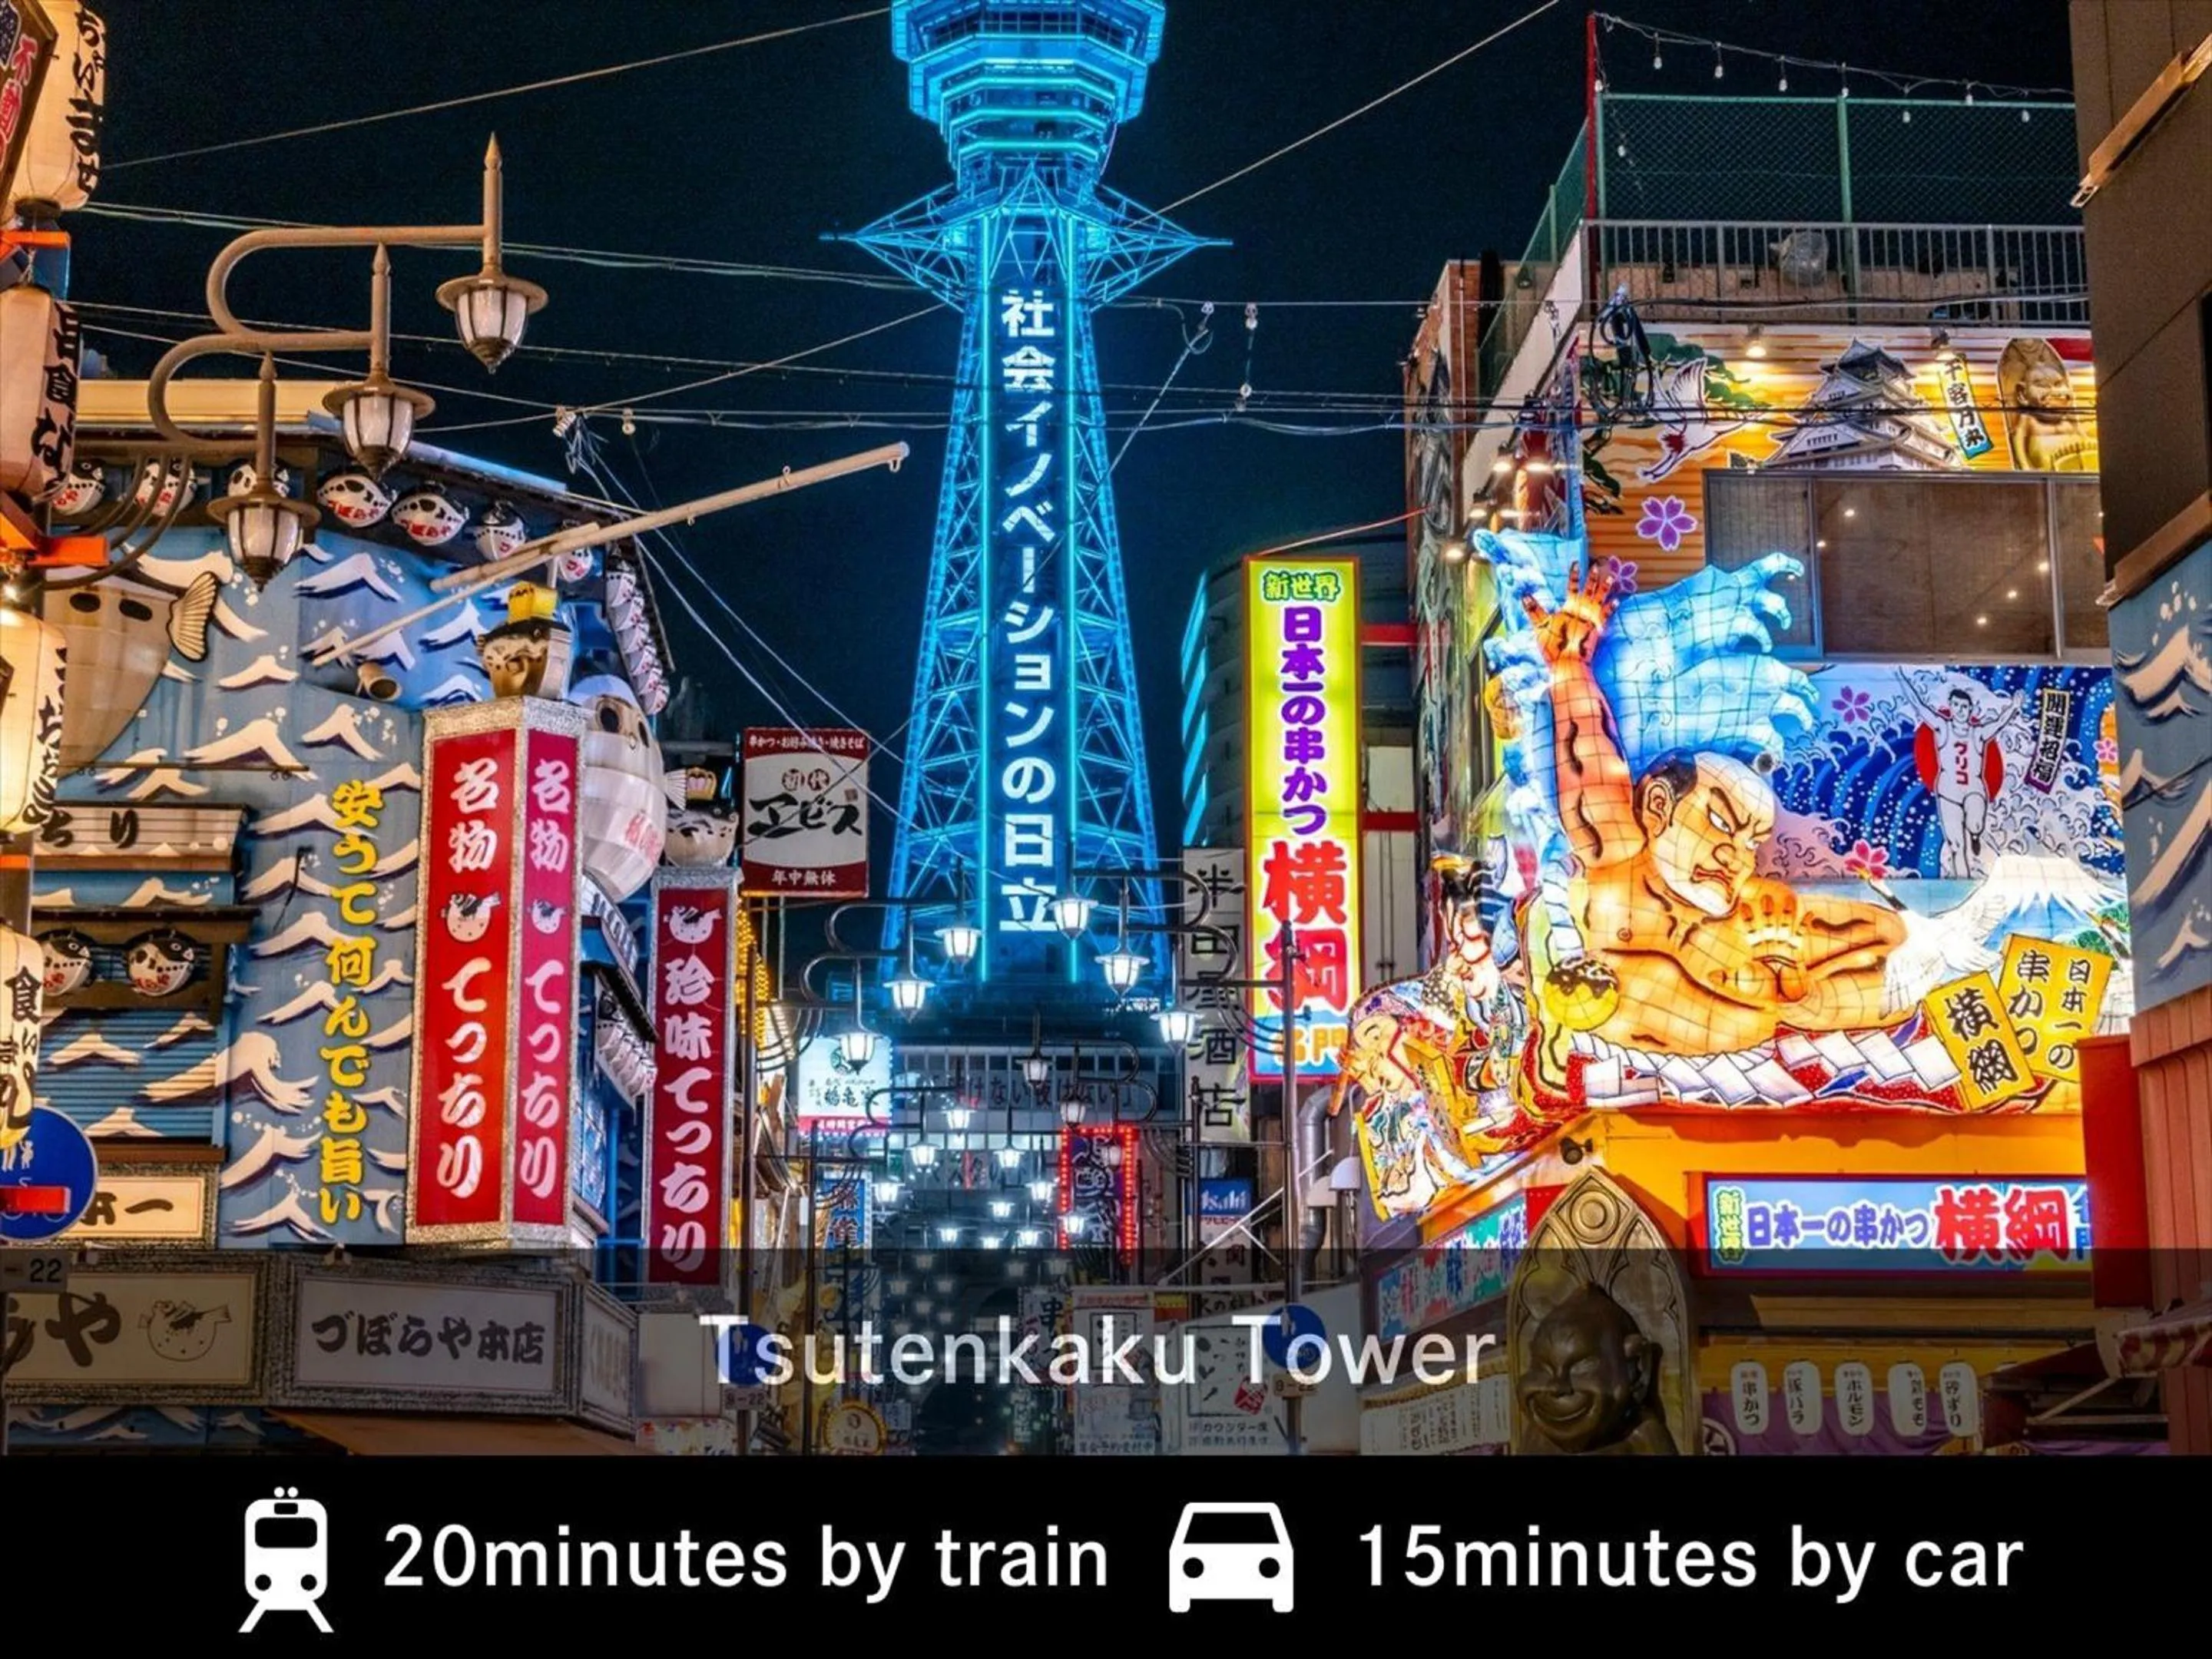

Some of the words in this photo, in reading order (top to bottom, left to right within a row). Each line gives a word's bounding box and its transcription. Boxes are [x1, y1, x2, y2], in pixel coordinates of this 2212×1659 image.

[1001, 290, 1057, 932] 社会イノベーションの日立
[1263, 571, 1342, 601] 新世界
[1280, 607, 1328, 836] 日本一の串かつ
[448, 757, 498, 873] 名物
[530, 758, 571, 874] 名物
[1263, 840, 1348, 1012] 横綱
[320, 780, 385, 1224] 安うて何んでも旨い
[1945, 987, 2019, 1094] 横綱
[2008, 949, 2051, 1056] 串かつ
[436, 956, 493, 1199] てっちり
[519, 958, 565, 1199] てっちり
[660, 954, 716, 1273] 珍味てっちり
[1747, 1204, 1929, 1246] 日本一の串かつ
[1935, 1187, 2071, 1261] 横綱
[311, 1310, 545, 1364] づぼらや本店
[1742, 1381, 1760, 1426] 串かつ
[1846, 1379, 1864, 1427] ホルモン
